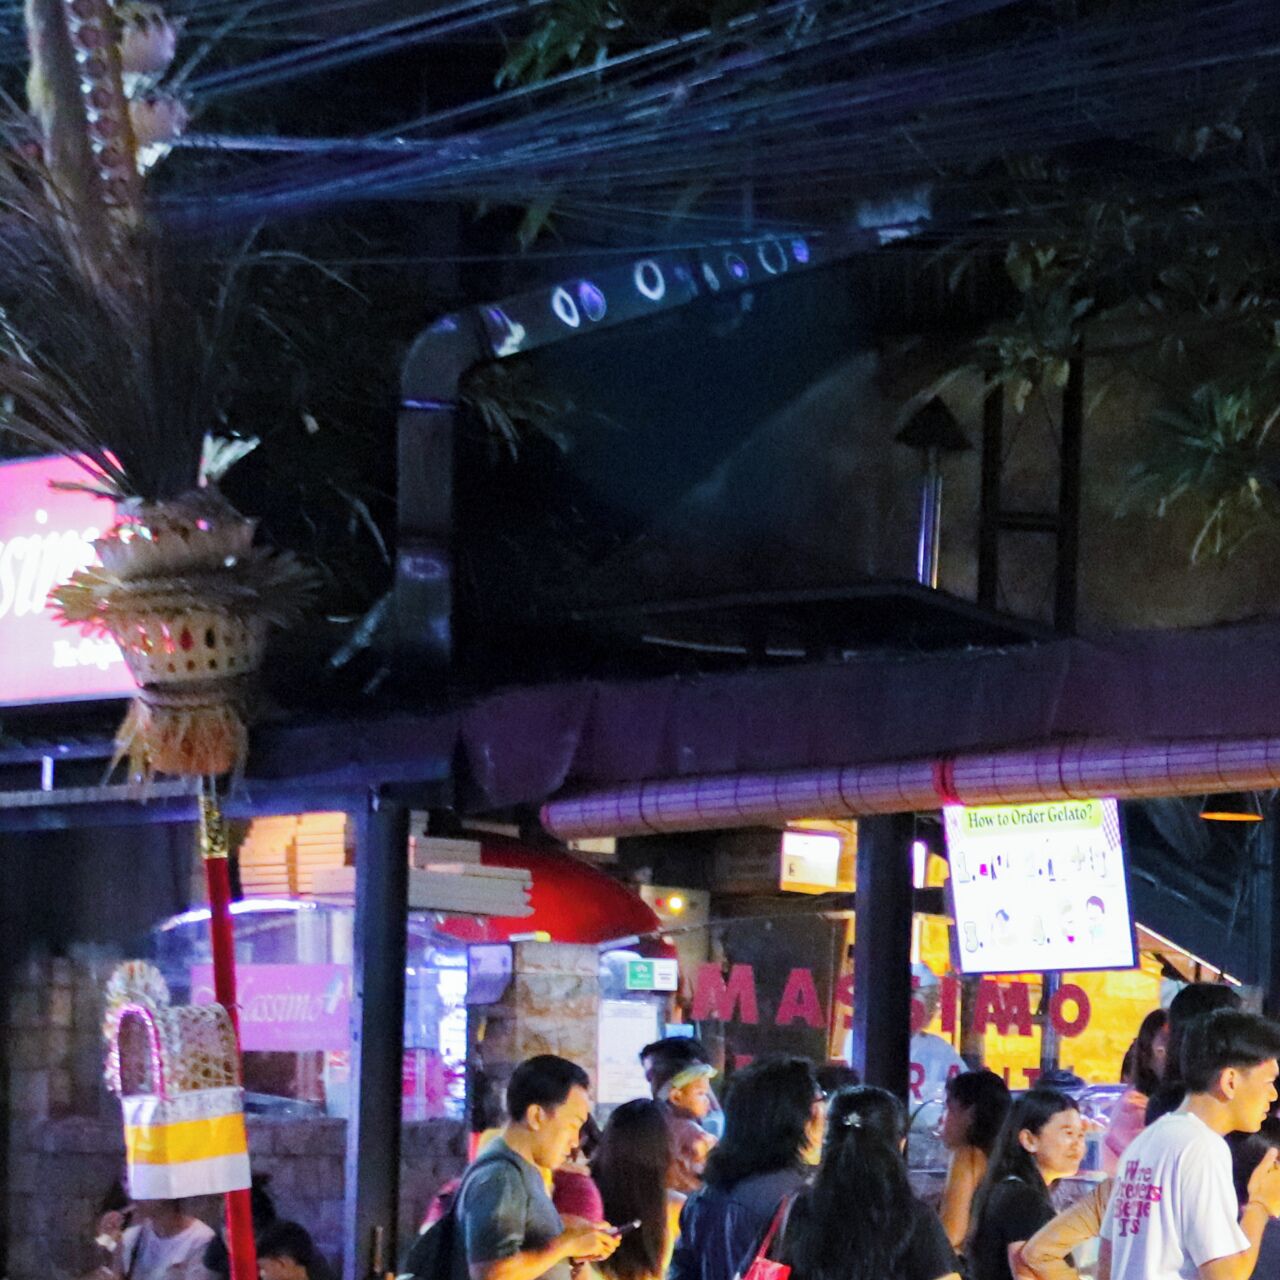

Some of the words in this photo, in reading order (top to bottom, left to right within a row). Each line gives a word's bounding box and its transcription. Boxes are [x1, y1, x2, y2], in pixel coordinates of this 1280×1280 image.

[968, 811, 994, 829] How
[998, 812, 1008, 826] to
[1011, 807, 1045, 825] Order
[1047, 804, 1093, 823] Gelato?
